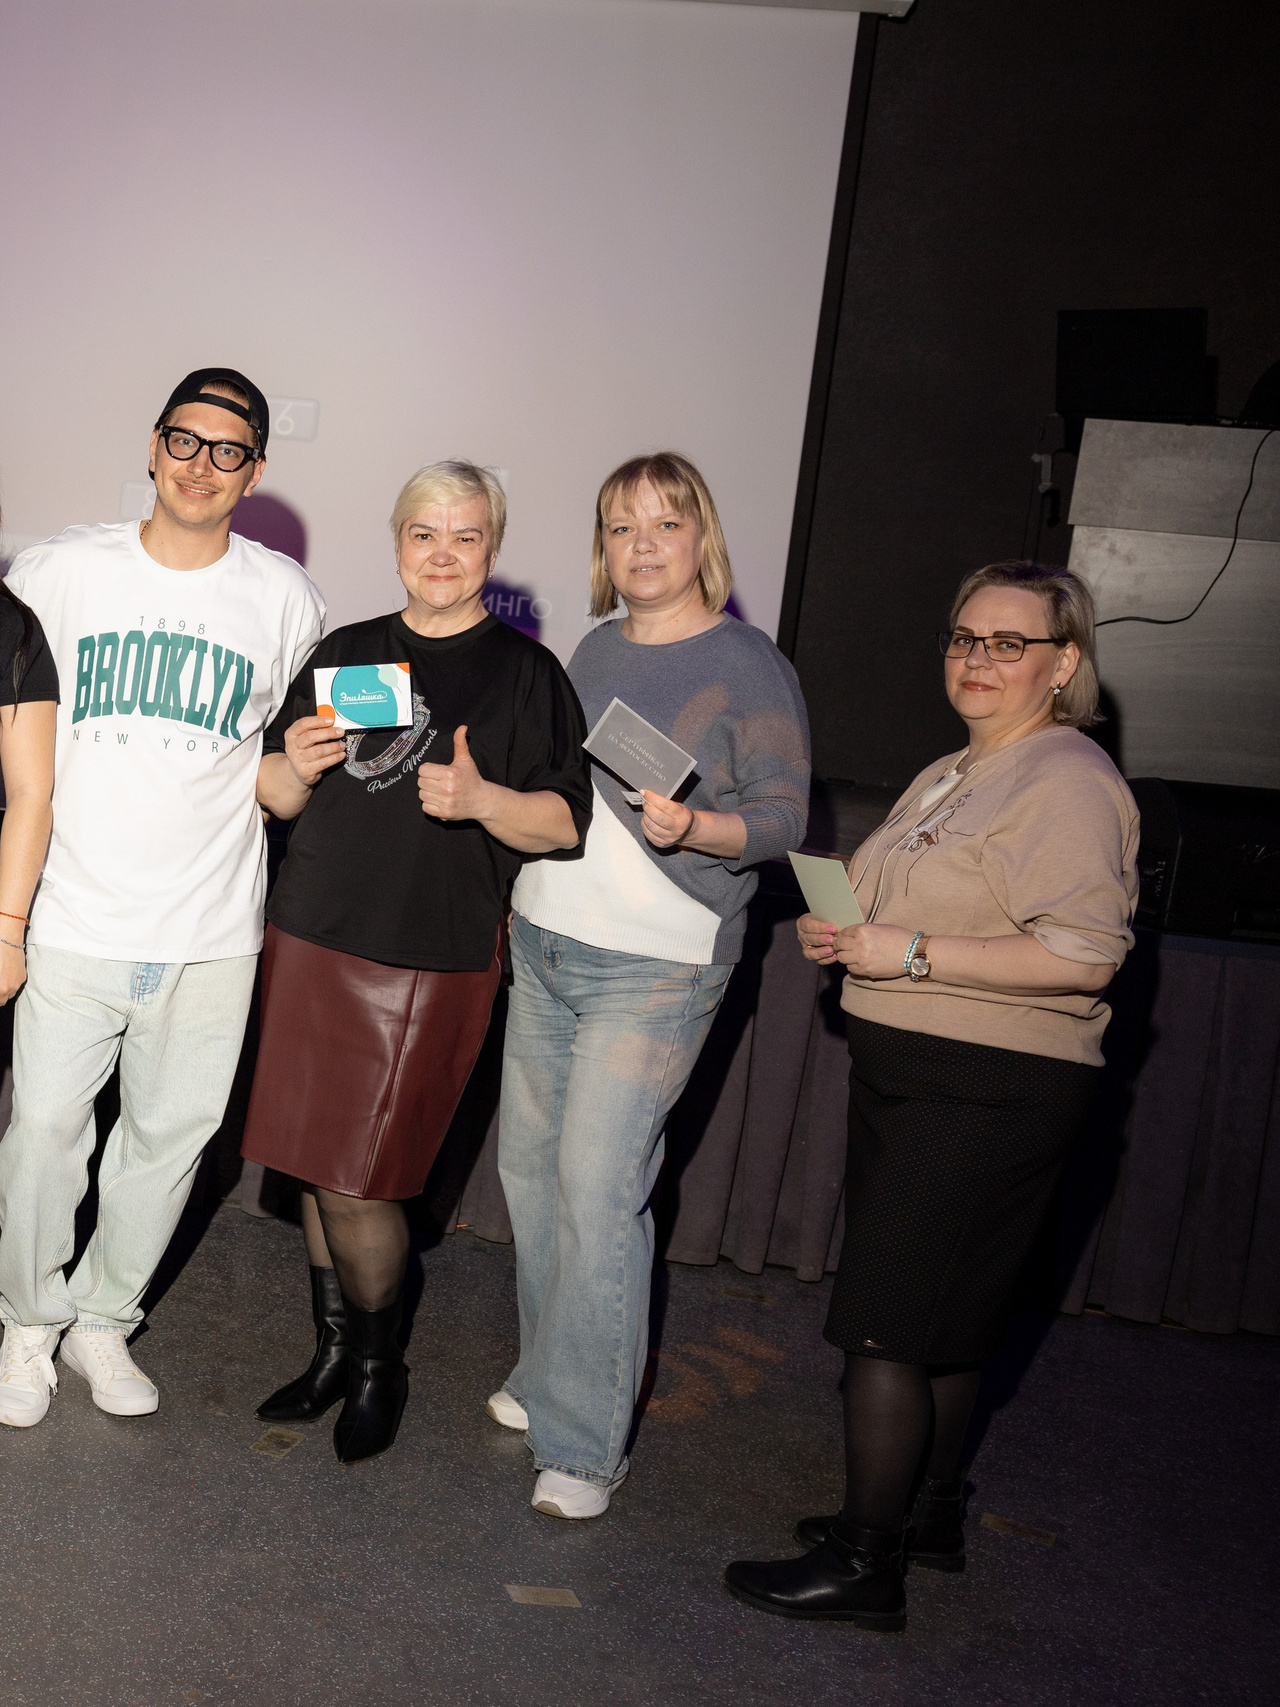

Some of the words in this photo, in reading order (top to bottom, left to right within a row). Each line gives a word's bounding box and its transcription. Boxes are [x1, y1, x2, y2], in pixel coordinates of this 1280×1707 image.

[138, 615, 206, 635] 1898
[72, 630, 255, 742] BROOKLYN
[72, 729, 129, 745] NEW
[619, 731, 664, 769] СЕРТИФИКАТ
[366, 772, 403, 793] Precious
[402, 728, 439, 774] Moments
[619, 742, 667, 782] ФОТОСЕССИЮ
